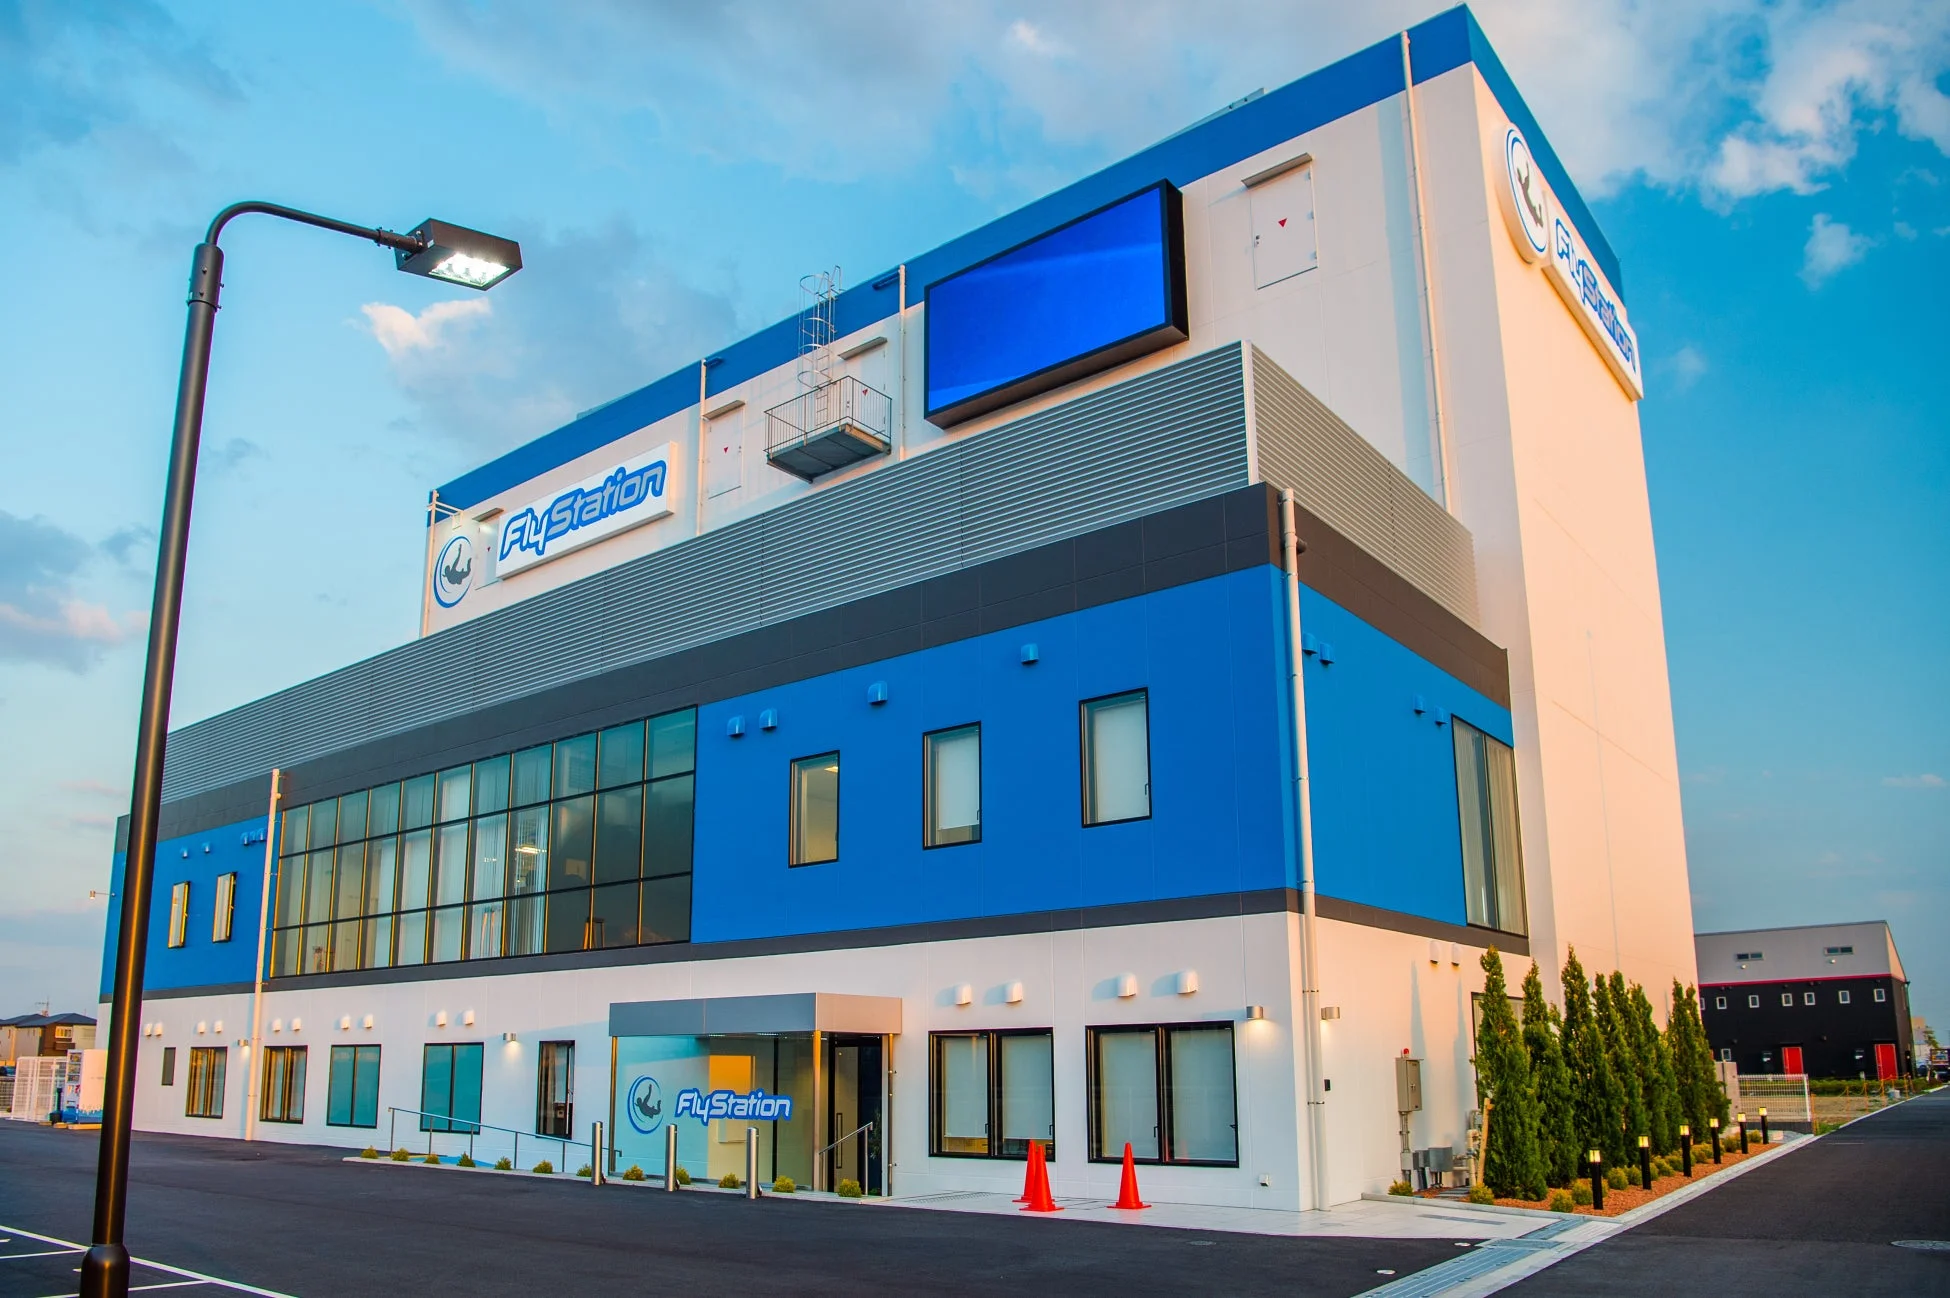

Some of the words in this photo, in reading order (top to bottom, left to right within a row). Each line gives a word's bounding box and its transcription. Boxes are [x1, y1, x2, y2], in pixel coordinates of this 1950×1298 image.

[1556, 218, 1636, 373] FlyStation
[499, 460, 667, 560] FlyStation
[675, 1088, 793, 1126] FlyStation
